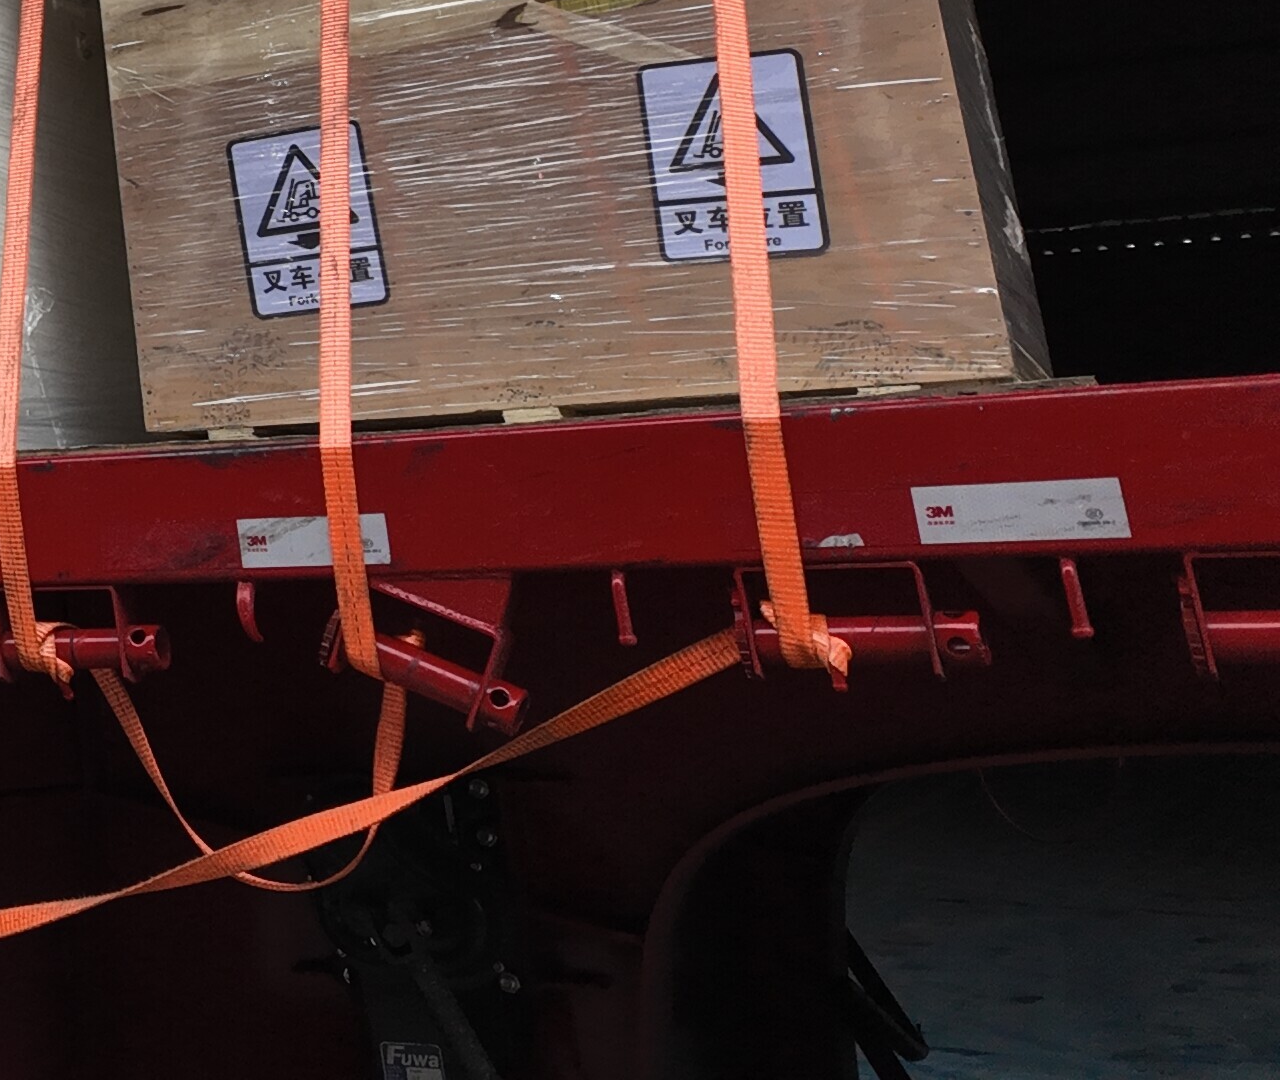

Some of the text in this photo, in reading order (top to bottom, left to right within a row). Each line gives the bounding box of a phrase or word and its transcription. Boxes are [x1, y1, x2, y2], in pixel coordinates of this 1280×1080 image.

[704, 238, 731, 251] For
[263, 256, 375, 294] 叉车置
[925, 505, 955, 519] 3M
[246, 535, 268, 547] 3M
[386, 1045, 439, 1068] Fuwa
